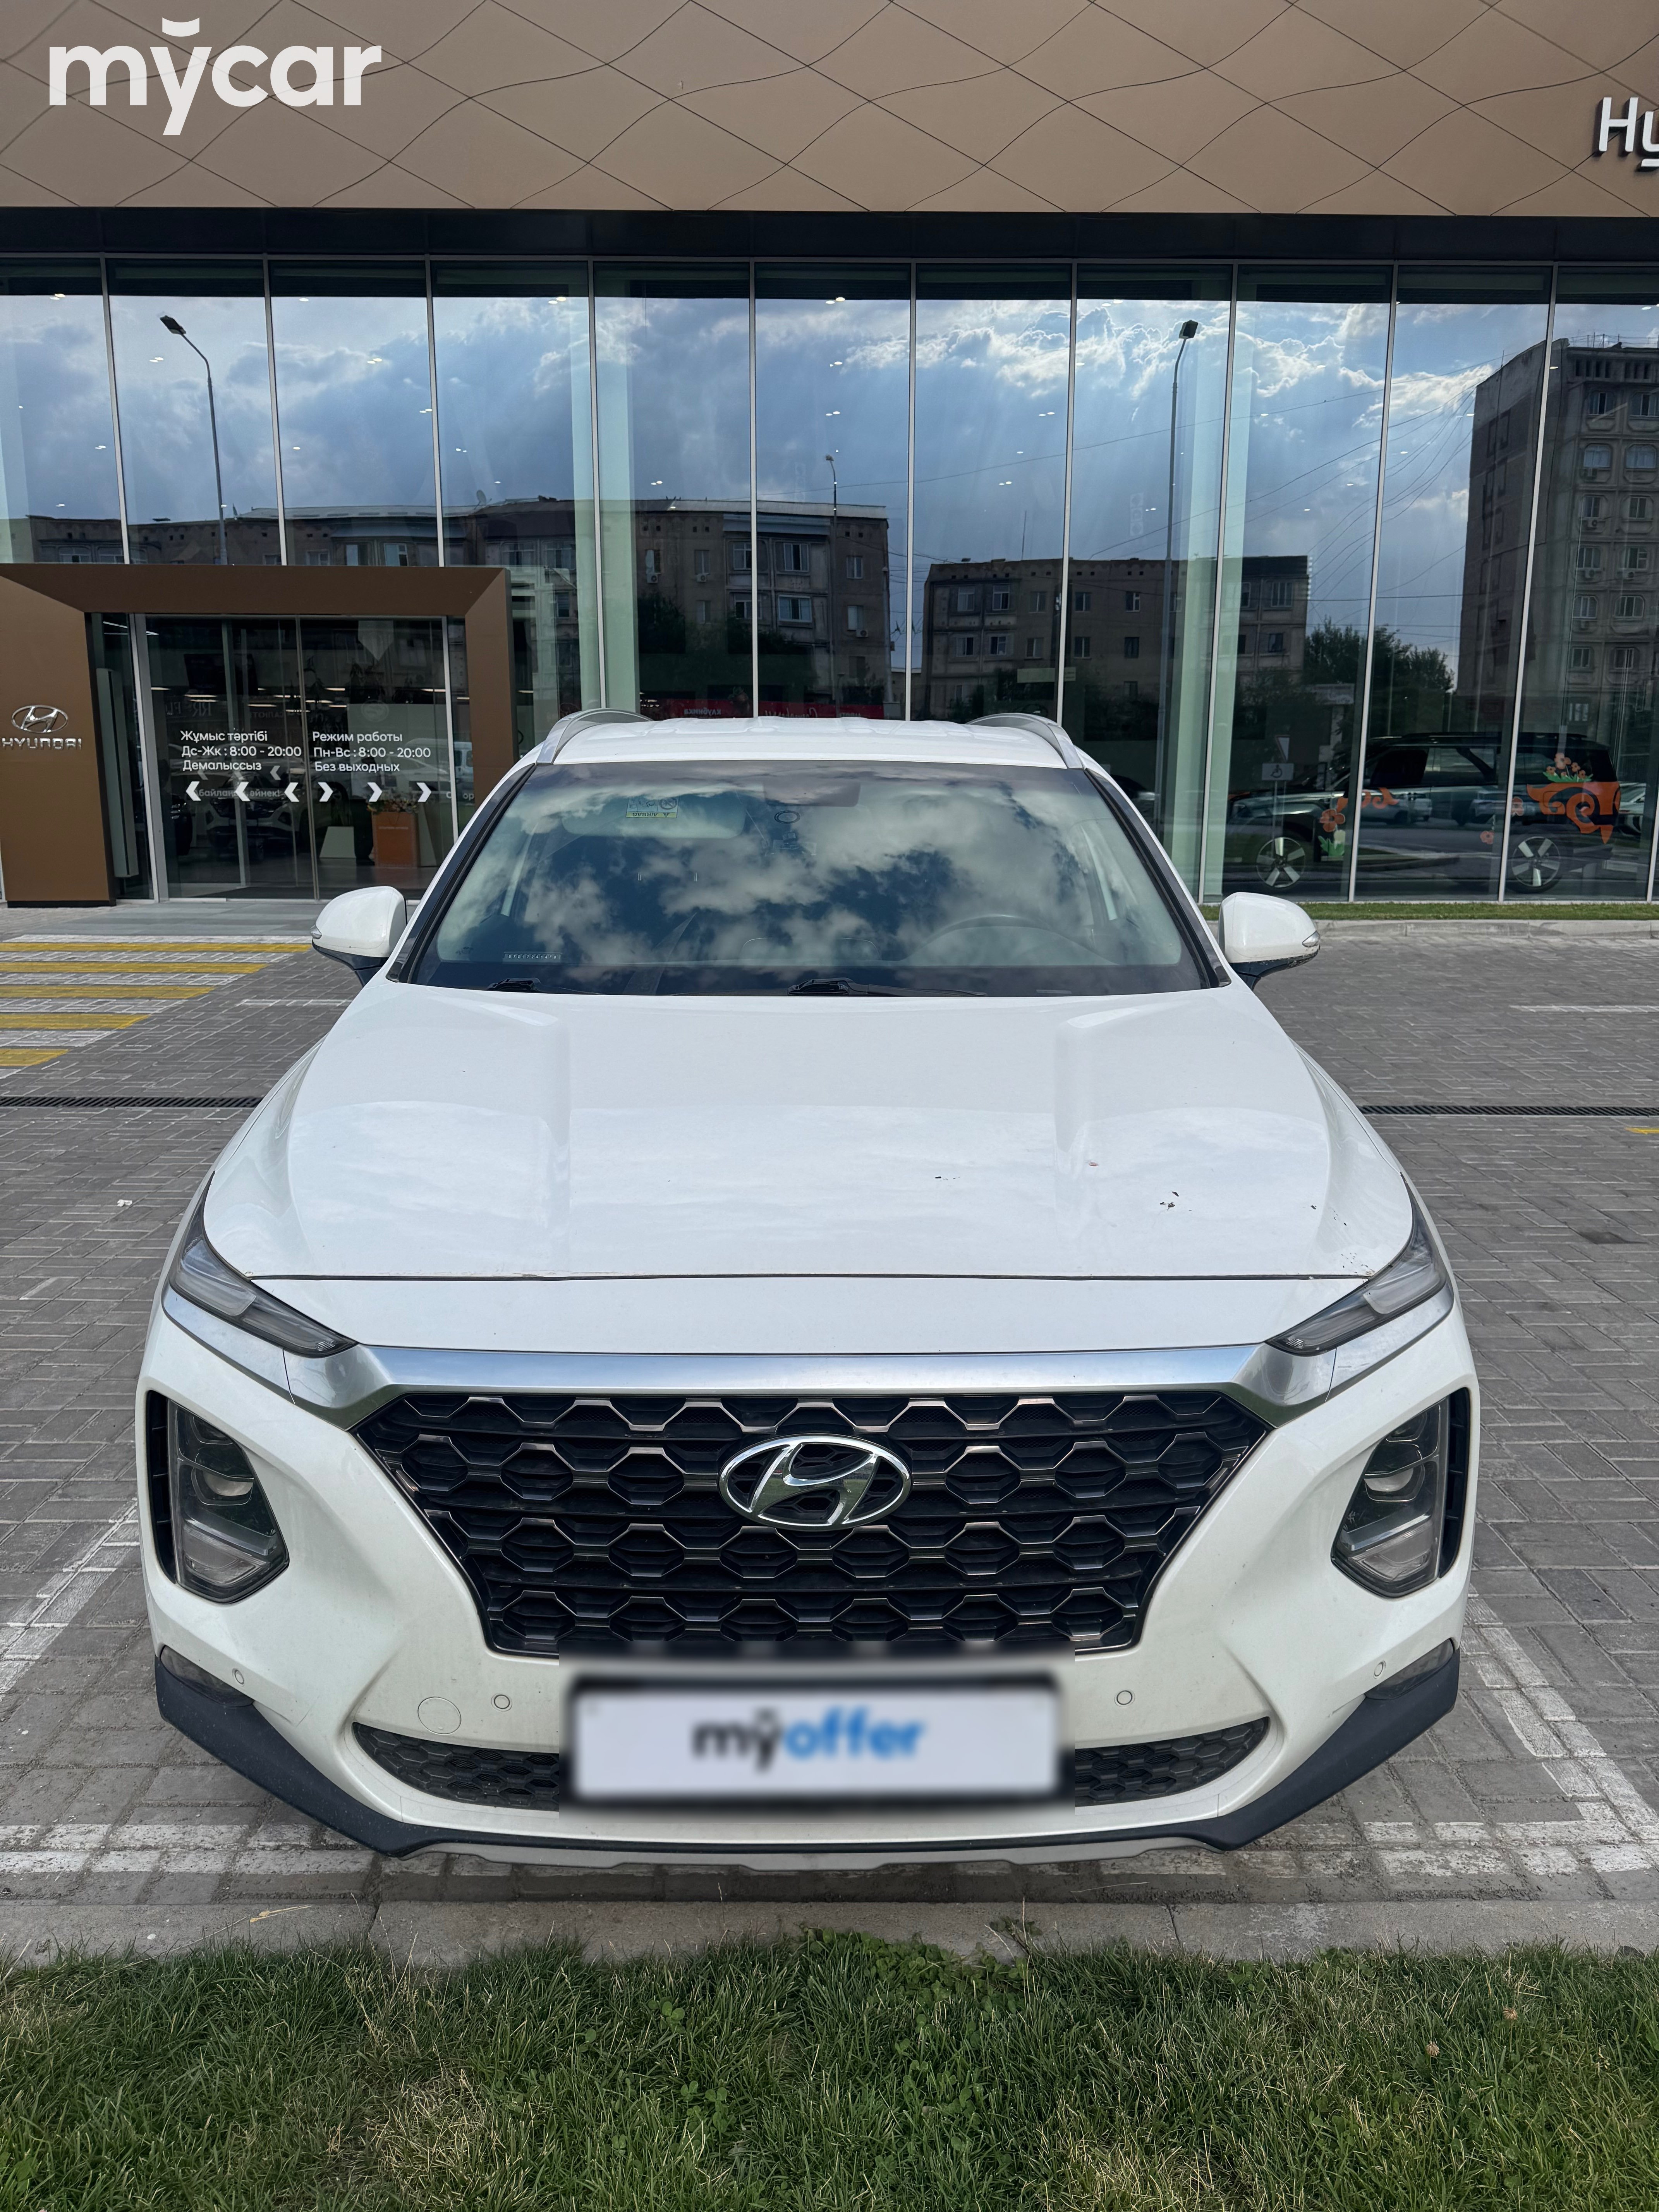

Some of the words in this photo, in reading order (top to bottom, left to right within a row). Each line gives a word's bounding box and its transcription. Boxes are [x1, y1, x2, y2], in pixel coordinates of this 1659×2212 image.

[180, 730, 225, 743] Жұмыс
[227, 730, 268, 743] тәртібі
[312, 731, 354, 742] Режим
[357, 731, 402, 744] работы
[2, 738, 81, 750] HYUNDAI
[268, 746, 301, 757] 20:00
[397, 747, 431, 758] 20:00
[182, 760, 262, 771] Демалыссыз
[315, 761, 336, 771] Без
[339, 763, 400, 773] выходных
